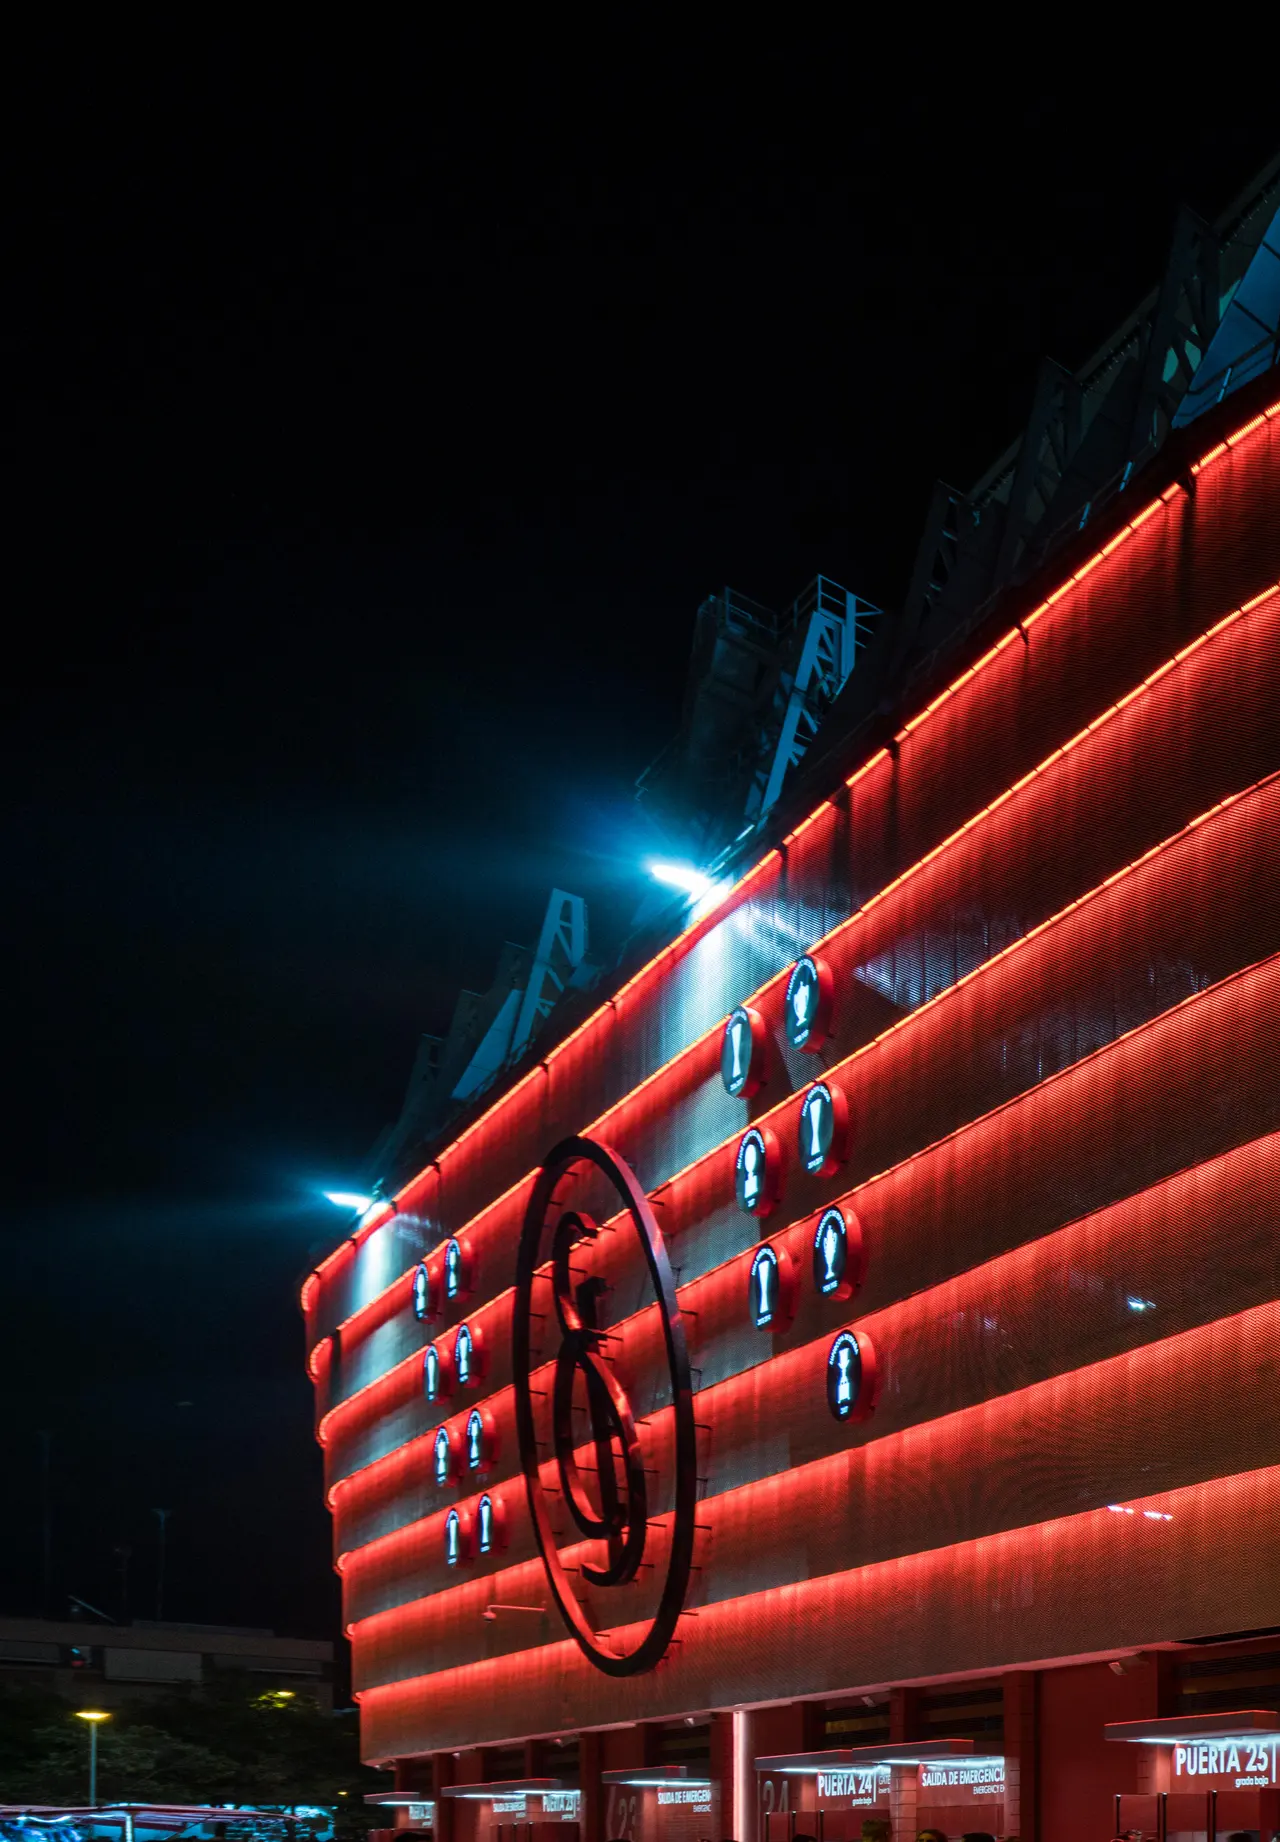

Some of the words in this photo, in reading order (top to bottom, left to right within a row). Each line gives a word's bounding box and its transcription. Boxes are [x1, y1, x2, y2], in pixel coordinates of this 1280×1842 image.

[1176, 1744, 1241, 1776] PUERTA
[1245, 1742, 1269, 1772] 25
[818, 1774, 857, 1797] PUERTA
[858, 1772, 873, 1794] 24
[922, 1771, 948, 1787] SALIDA
[948, 1770, 959, 1785] DE
[1235, 1777, 1254, 1788] grada
[1254, 1775, 1269, 1788] baja
